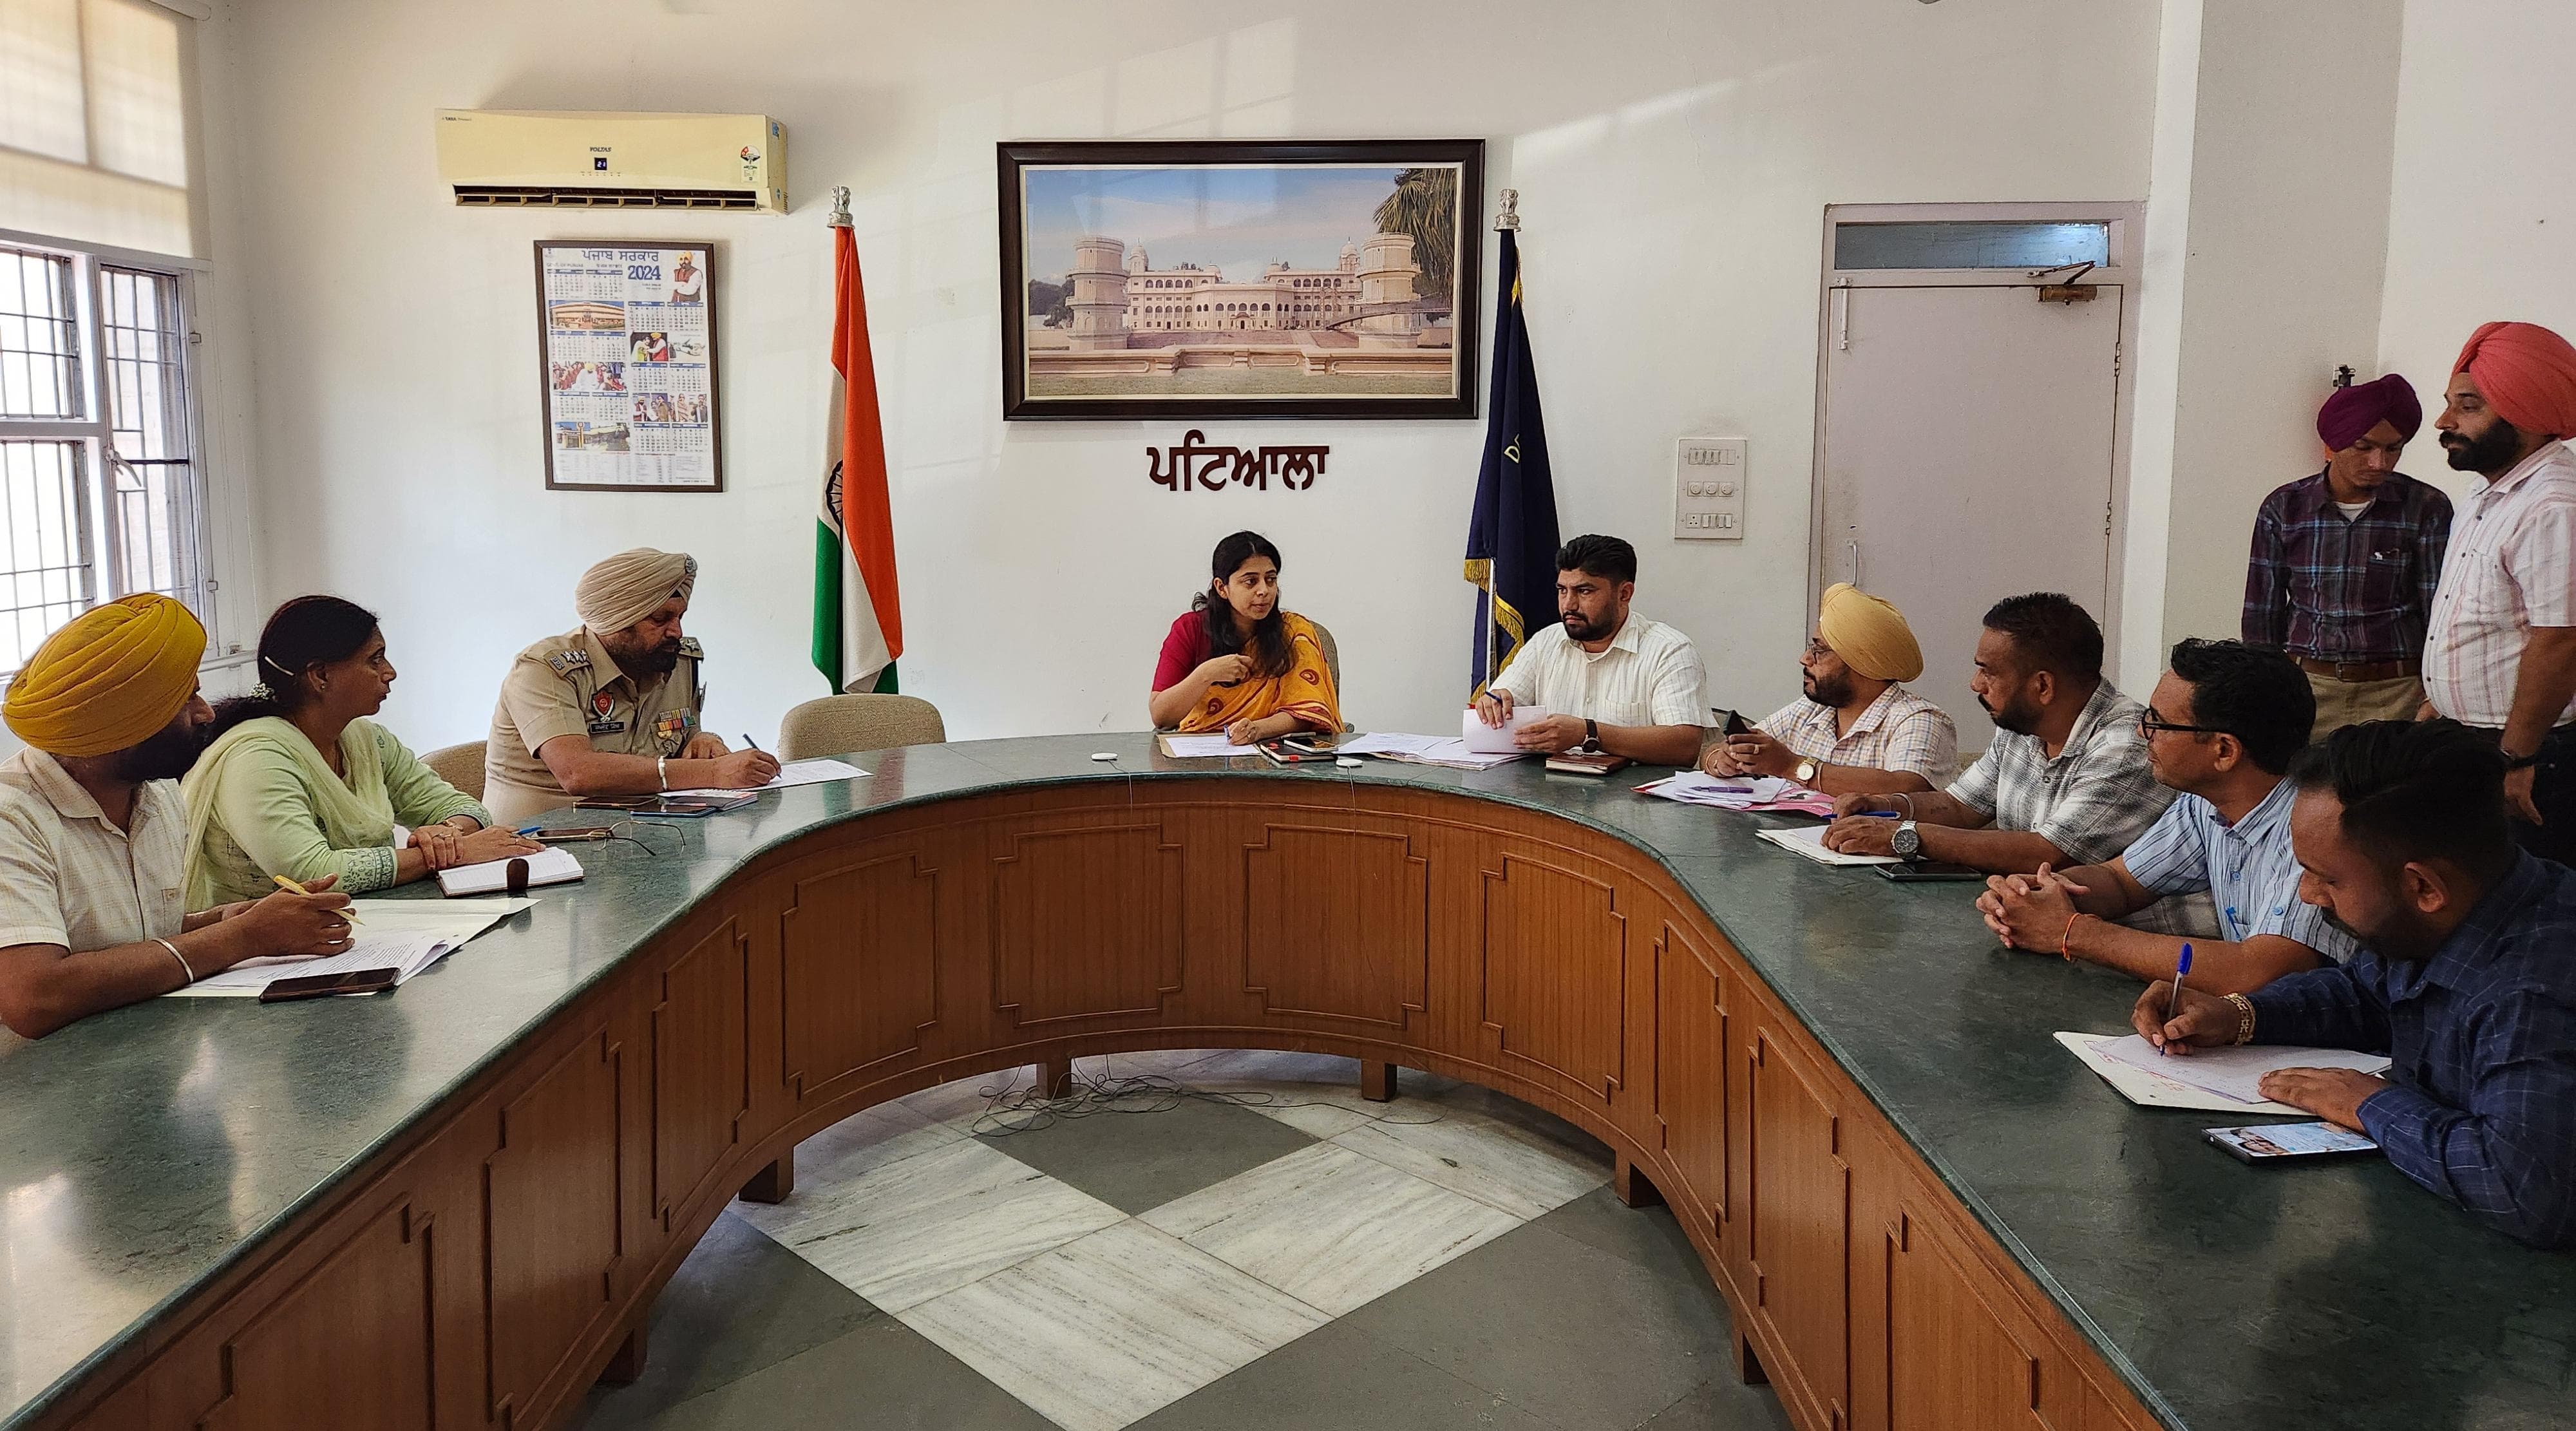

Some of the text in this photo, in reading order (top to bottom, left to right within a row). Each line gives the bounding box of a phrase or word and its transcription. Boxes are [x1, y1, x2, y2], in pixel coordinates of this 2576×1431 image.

[618, 251, 659, 261] ਸਰਕਾਰ
[627, 265, 661, 280] 2024
[1146, 429, 1330, 491] ਪਟਿਆਲਾ
